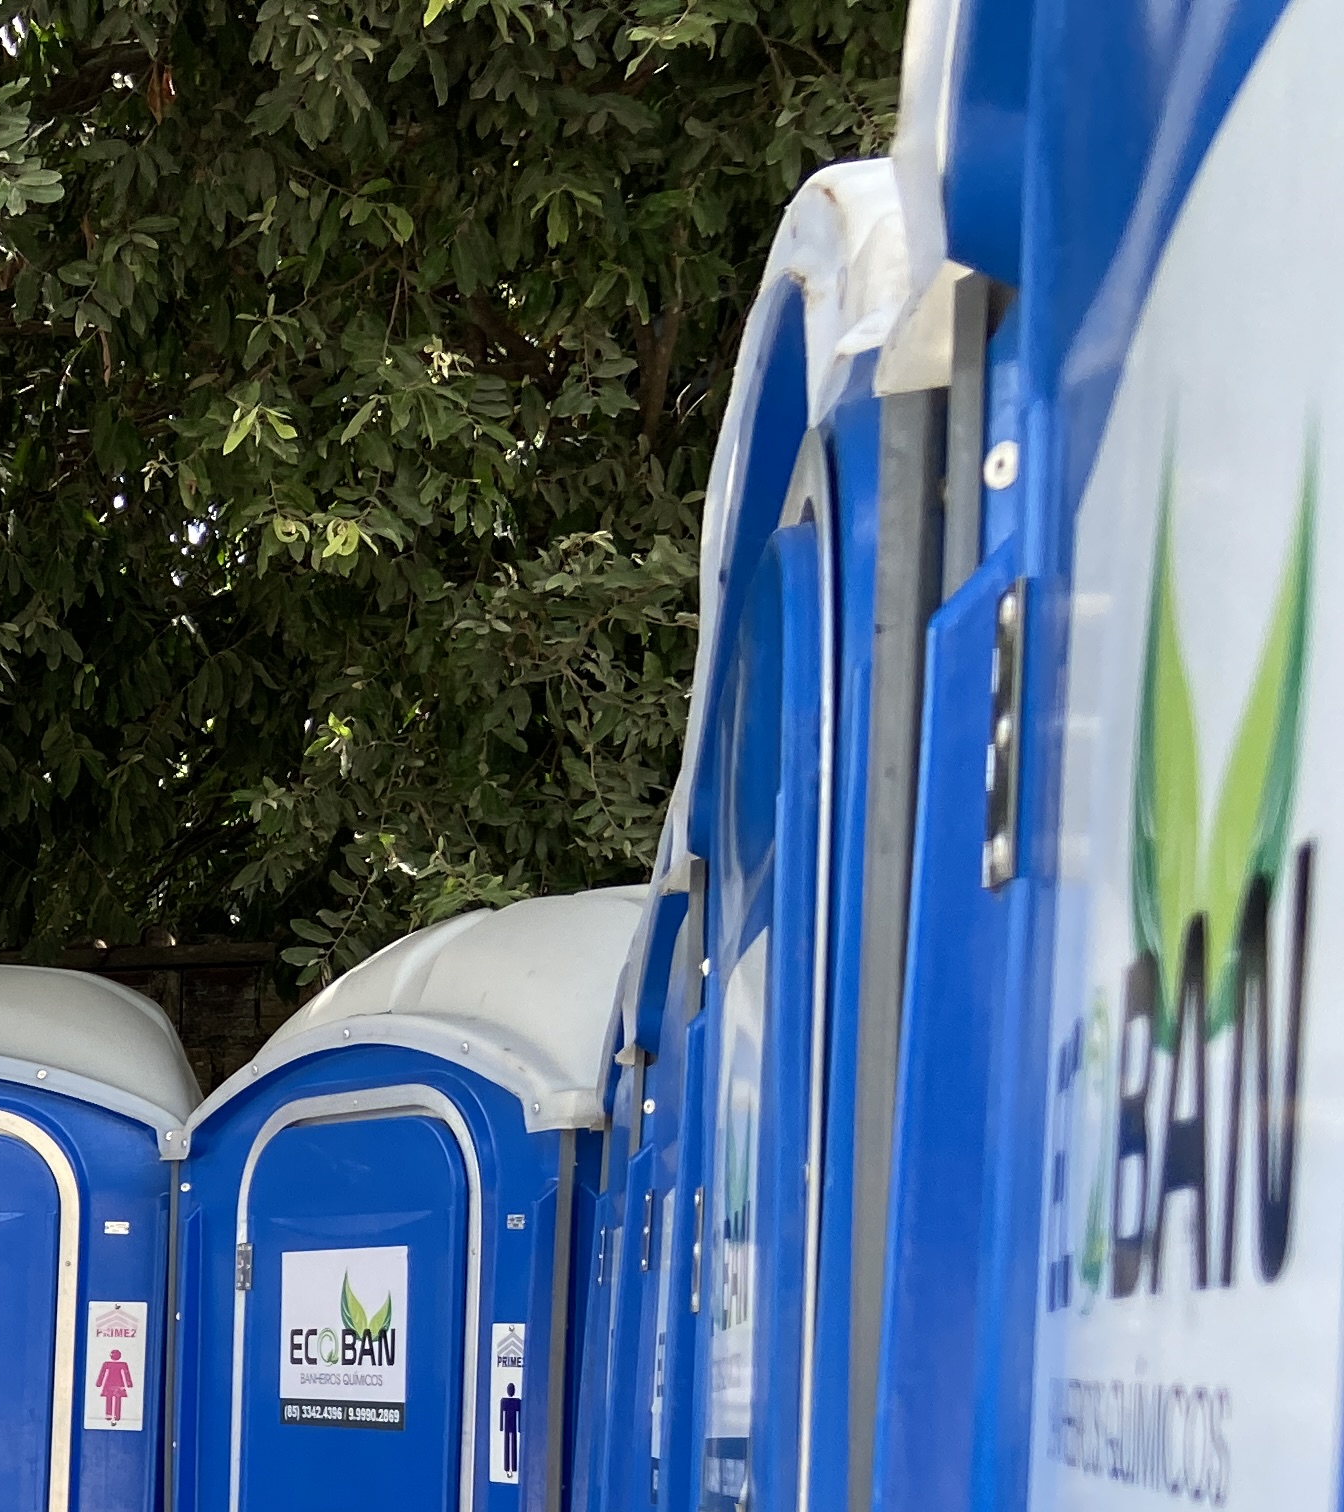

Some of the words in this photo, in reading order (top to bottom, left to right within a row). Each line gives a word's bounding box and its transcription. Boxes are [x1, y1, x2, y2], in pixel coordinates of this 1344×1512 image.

[290, 1328, 396, 1367] ECOBAN
[300, 1372, 341, 1385] BANHEIROS
[342, 1371, 383, 1387] QUÍMICOS
